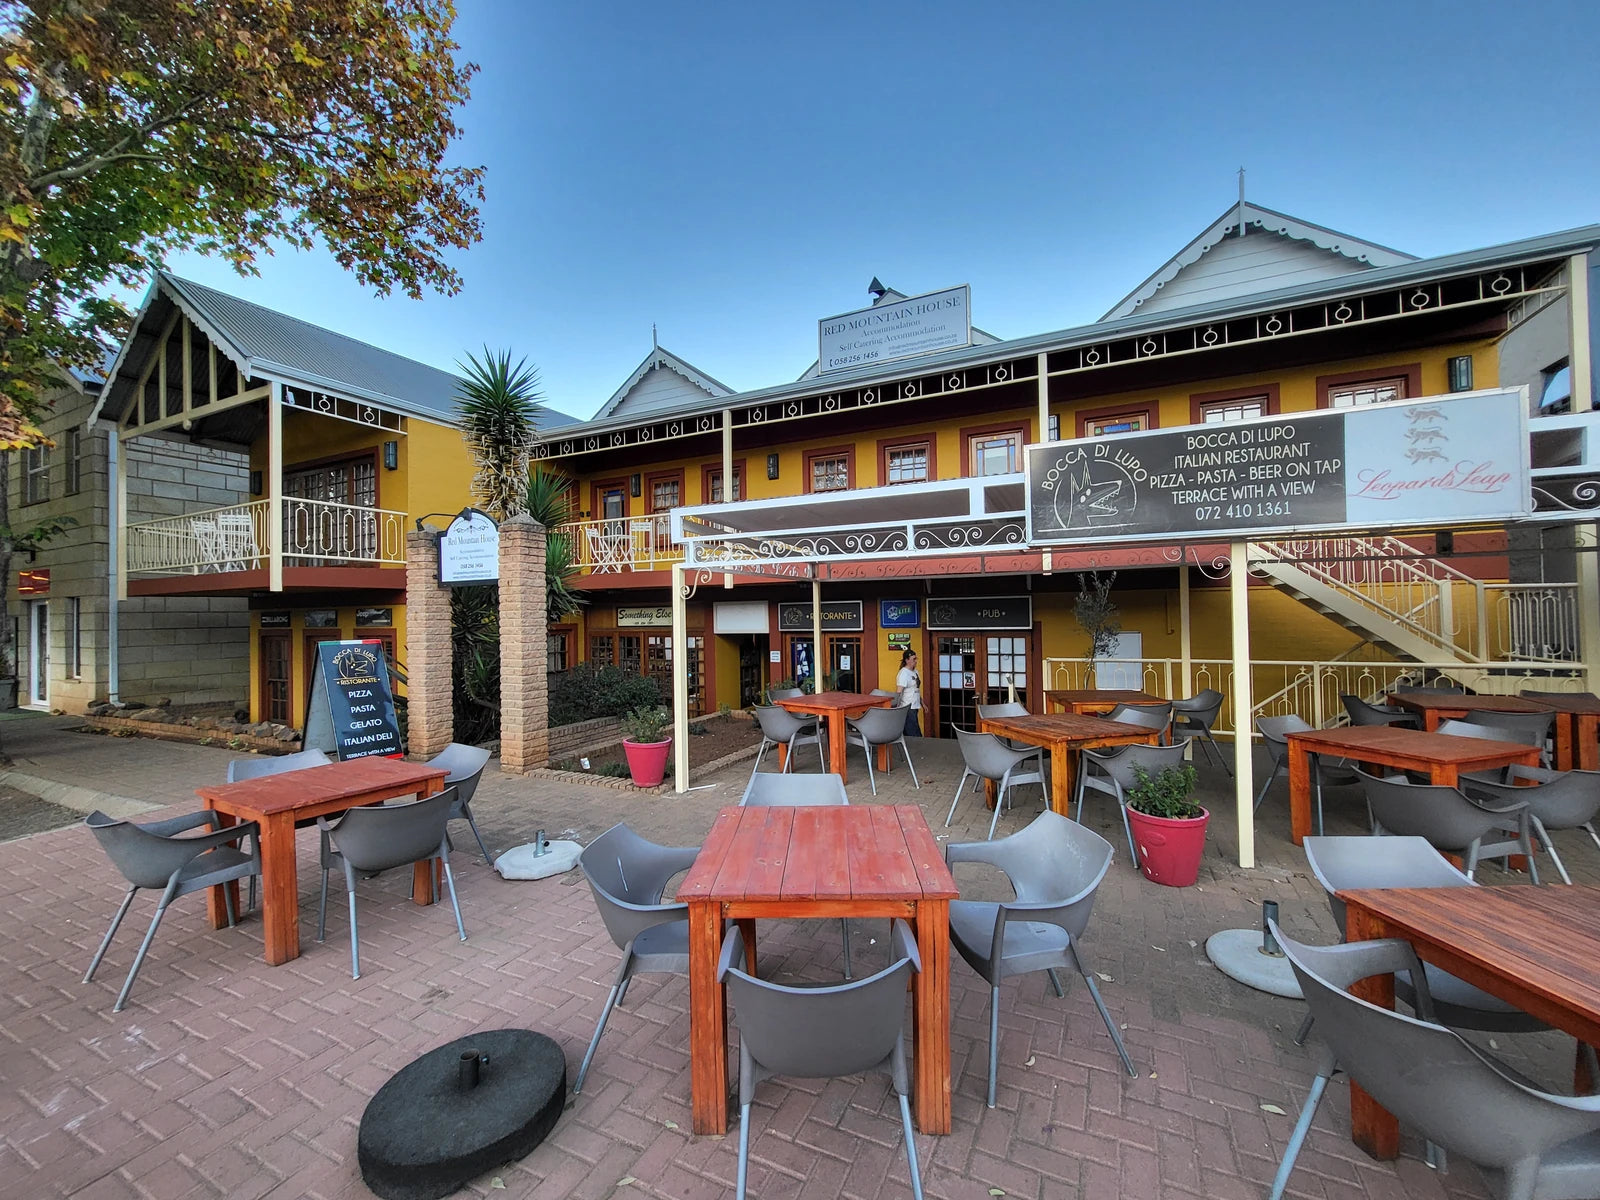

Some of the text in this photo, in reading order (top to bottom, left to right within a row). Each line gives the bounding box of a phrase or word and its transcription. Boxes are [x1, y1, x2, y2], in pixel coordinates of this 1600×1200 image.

[824, 297, 961, 336] RED MOUNTAIN HOUSE
[861, 319, 921, 337] Accommodation
[839, 324, 946, 352] Self Catering Accommodation
[834, 351, 879, 366] 058 256 1456
[1187, 425, 1295, 450] BOCCA DI LUPO
[1174, 442, 1311, 470] ITALIAN RESTAURANT
[1041, 444, 1148, 491] BOCCA DI LUPO
[1150, 473, 1186, 489] PIZZA
[1197, 468, 1237, 485] PASTA
[1249, 465, 1282, 481] BEER
[1285, 461, 1311, 478] ON
[1314, 458, 1342, 475] TAP
[1348, 459, 1512, 500] Leopard's Leap
[1172, 479, 1316, 505] TERRACE WITH A VIEW
[1195, 501, 1291, 521] 072 410 1361
[619, 608, 672, 621] Something Else
[809, 612, 852, 620] RTORANTE
[898, 607, 912, 615] LITE
[982, 609, 1001, 618] PUB
[332, 648, 352, 665] BOCCA
[362, 649, 378, 662] LUPO
[340, 677, 378, 685] RISTORANTE
[348, 690, 373, 698] PIZZA
[350, 704, 376, 714] PASTA
[350, 718, 382, 730] GELATO
[344, 732, 393, 747] ITALIAN DELI
[346, 751, 368, 759] TERRACE
